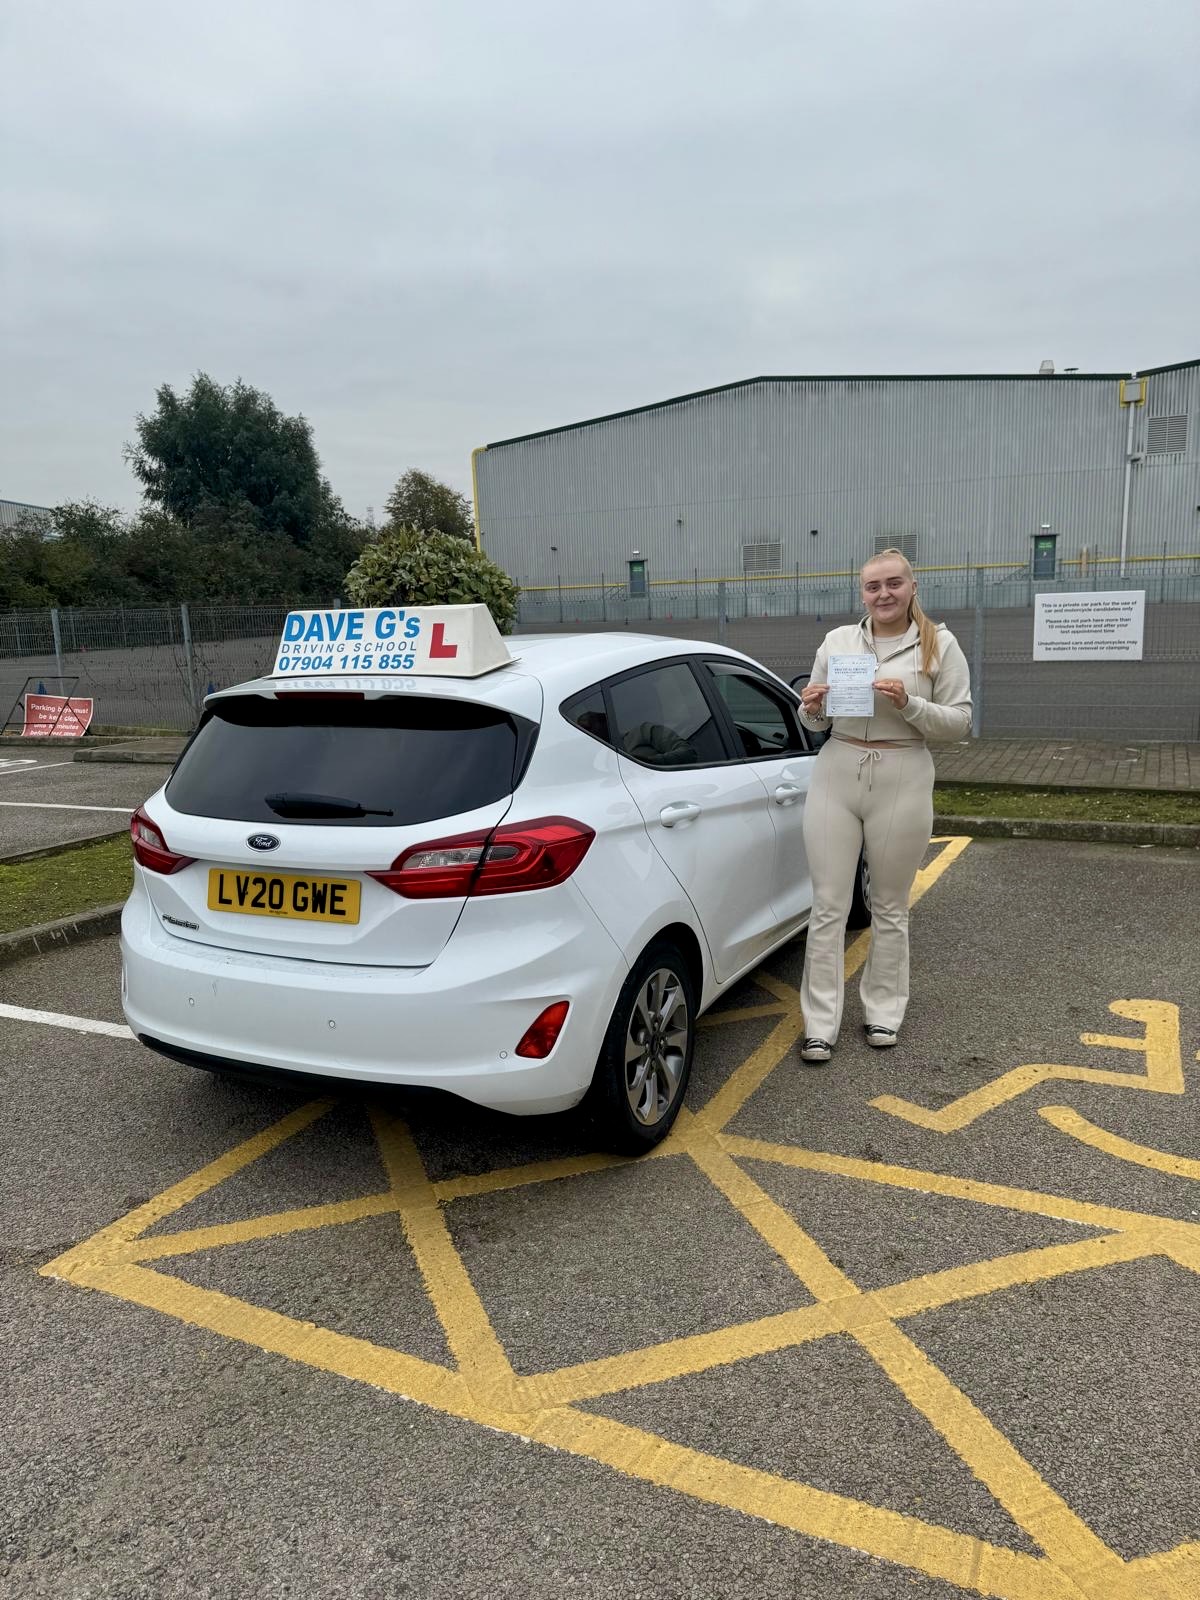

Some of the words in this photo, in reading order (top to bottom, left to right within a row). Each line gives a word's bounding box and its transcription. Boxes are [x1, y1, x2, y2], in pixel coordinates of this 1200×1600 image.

[283, 612, 365, 642] DAVE
[375, 610, 421, 640] G's
[281, 643, 345, 654] DRIVING
[353, 641, 417, 652] SCHOOL
[429, 623, 458, 658] L
[278, 655, 334, 671] 07904
[340, 654, 374, 670] 115
[380, 654, 416, 670] 855
[31, 704, 56, 712] Parking
[253, 836, 273, 848] Ford
[218, 874, 284, 910] LV20
[292, 881, 348, 916] GWE
